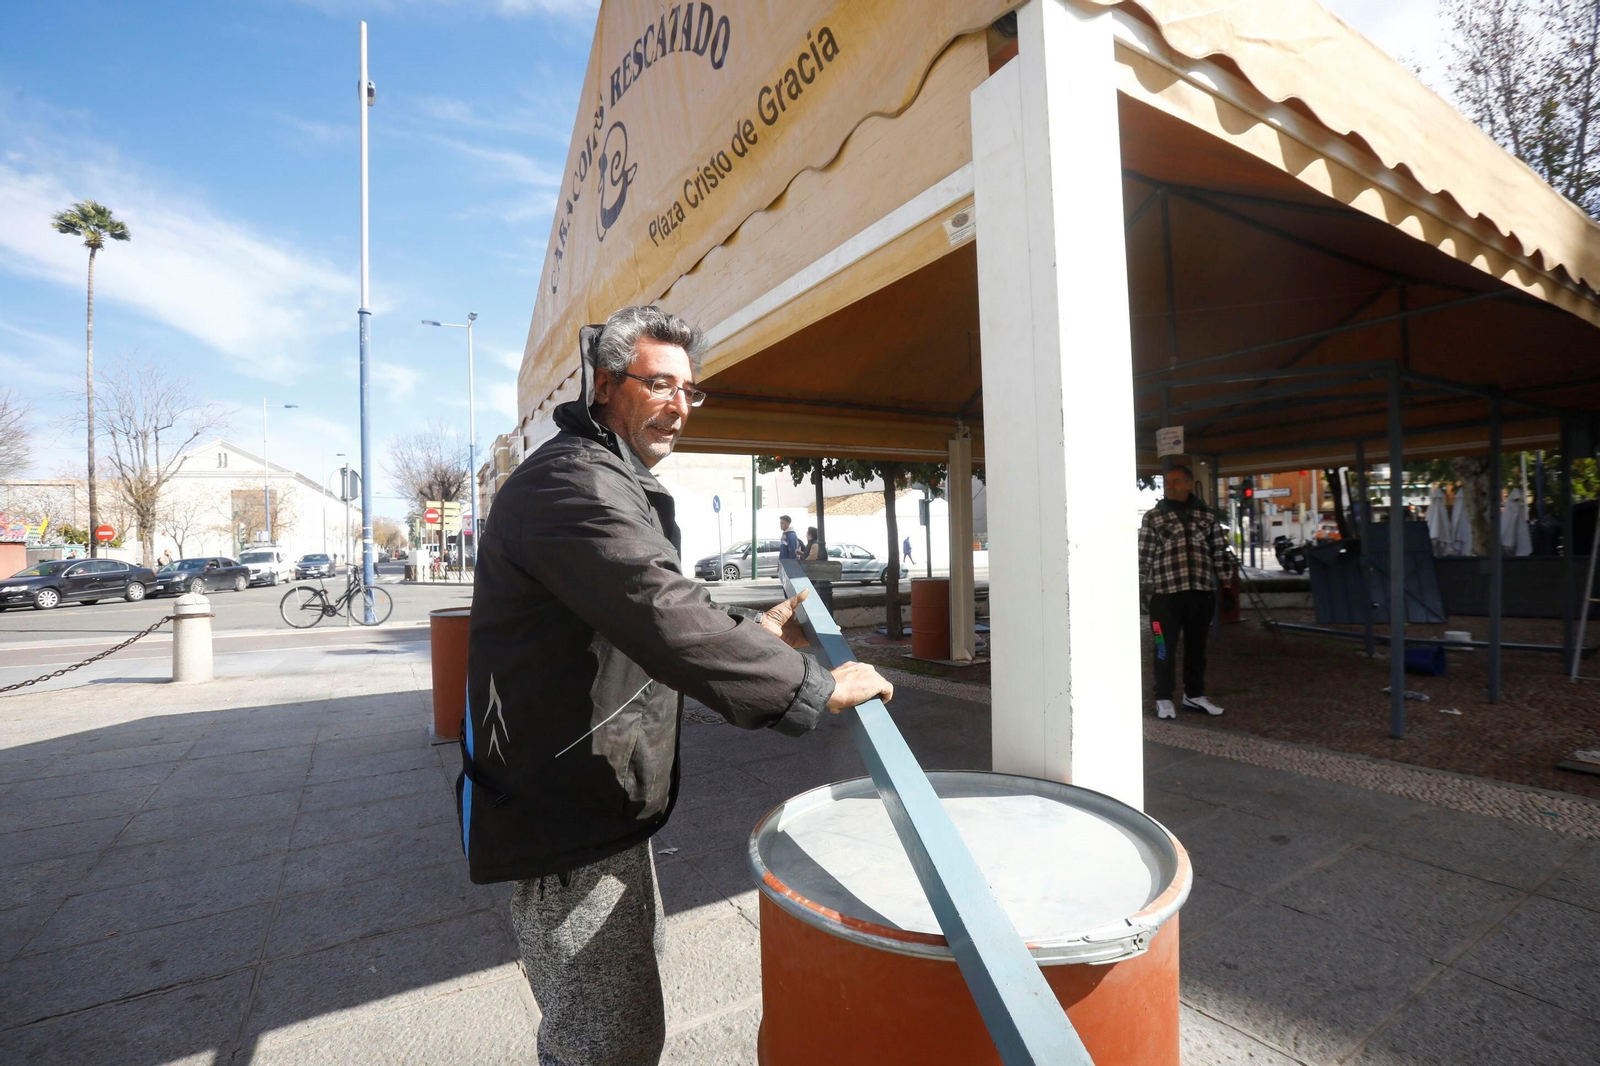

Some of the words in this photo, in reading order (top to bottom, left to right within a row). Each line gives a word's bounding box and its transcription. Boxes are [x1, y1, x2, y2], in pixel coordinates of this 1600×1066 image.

[610, 2, 731, 110] RESCATADO
[648, 201, 686, 247] Plaza
[683, 150, 732, 209] Cristo
[731, 119, 758, 158] de
[757, 26, 840, 126] Gracia
